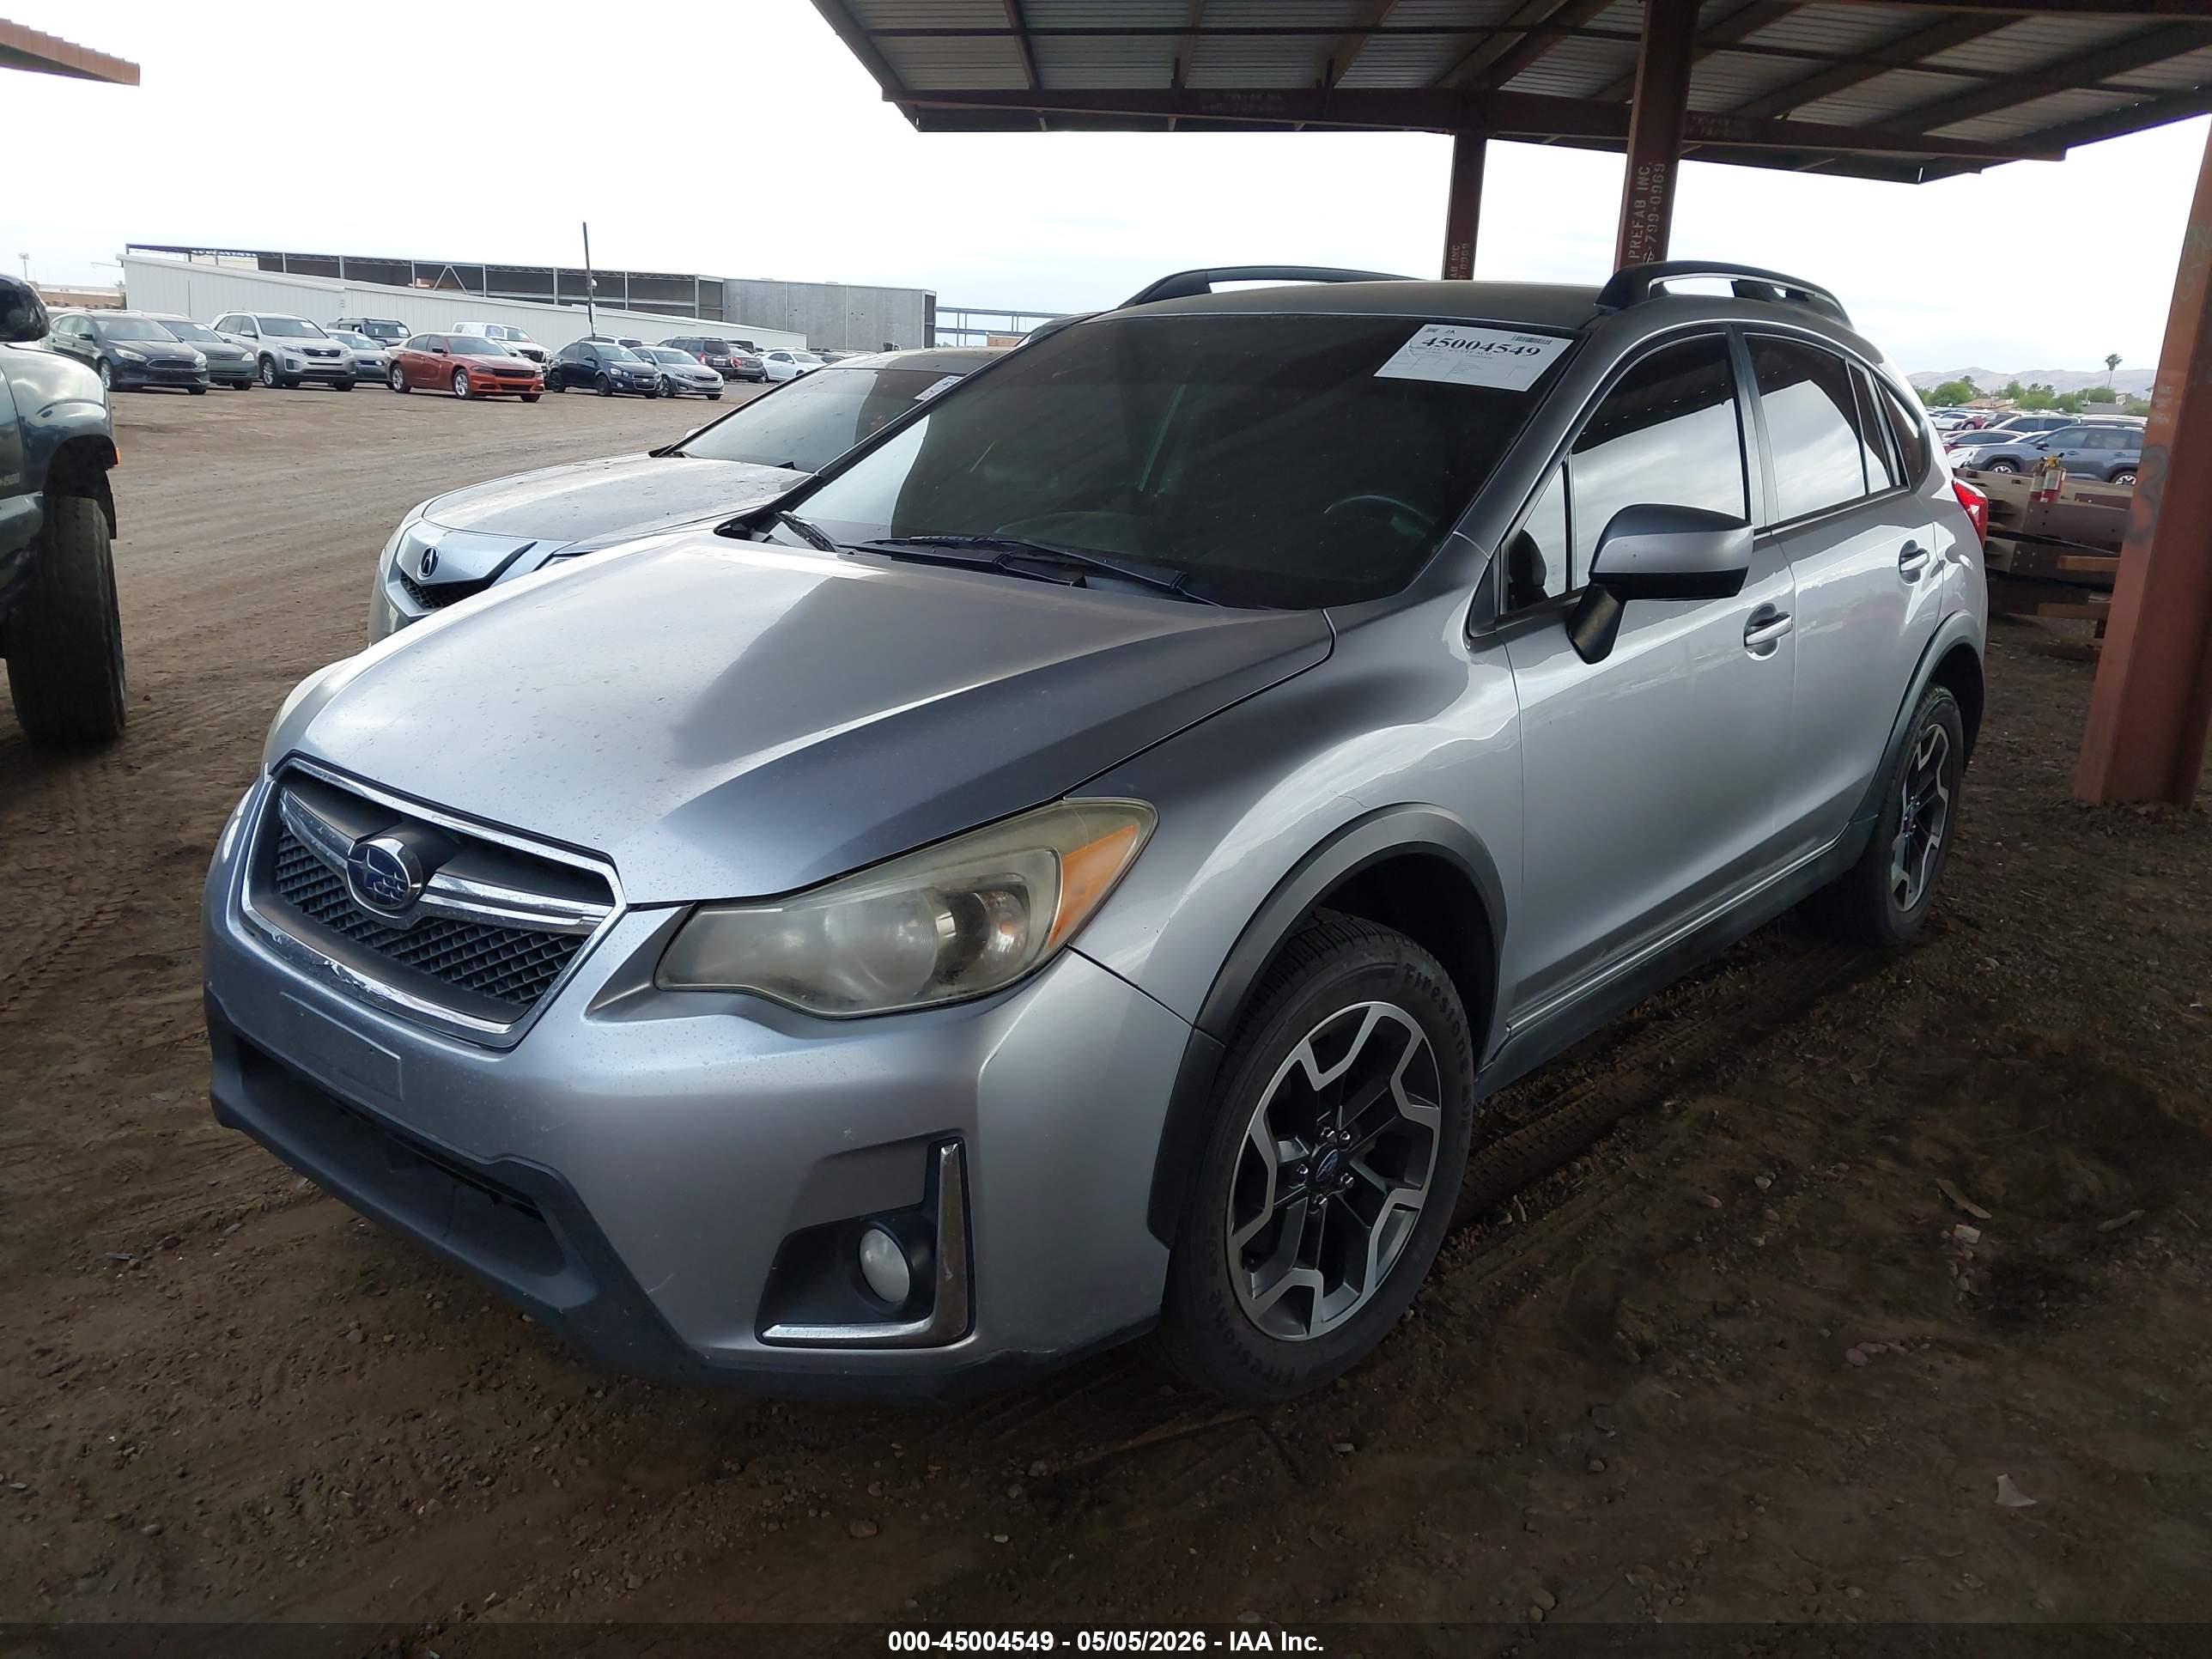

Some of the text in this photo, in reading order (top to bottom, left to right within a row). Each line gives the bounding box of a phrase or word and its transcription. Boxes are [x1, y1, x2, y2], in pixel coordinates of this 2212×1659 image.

[1628, 161, 1652, 259] PREFAB INC.
[1421, 336, 1541, 358] 45004549
[1403, 962, 1470, 1076] Firestone
